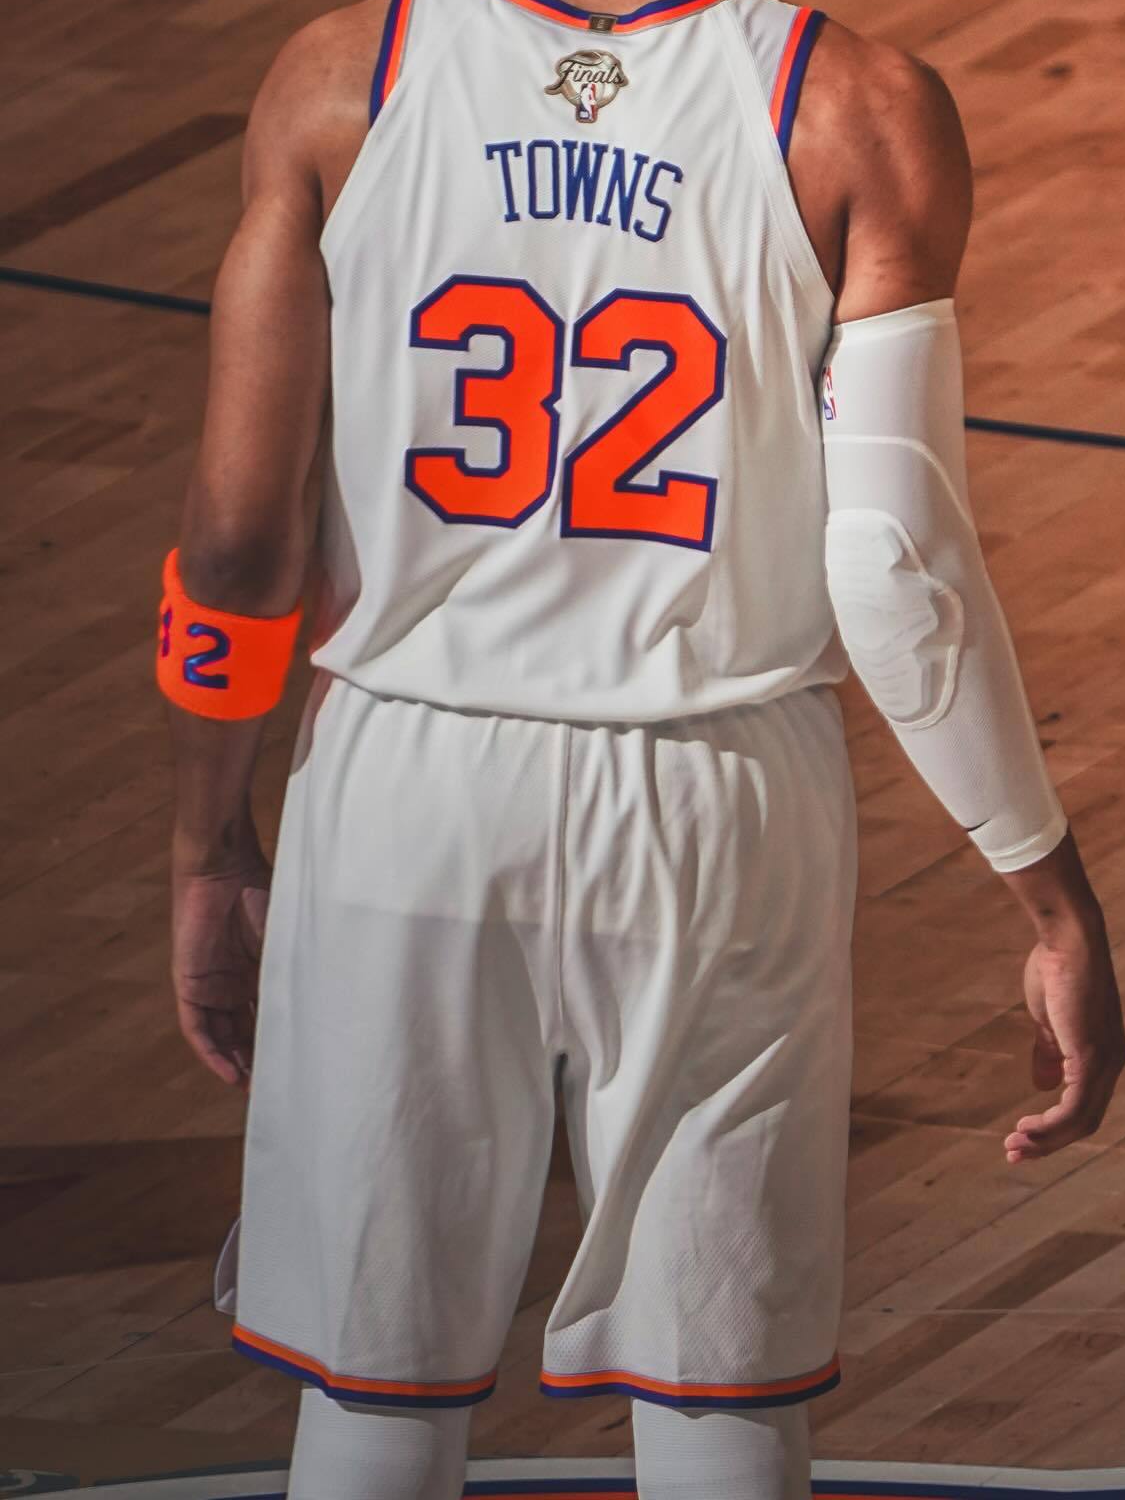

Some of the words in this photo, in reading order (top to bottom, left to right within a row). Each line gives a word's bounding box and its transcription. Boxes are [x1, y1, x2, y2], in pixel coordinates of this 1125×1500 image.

[545, 57, 626, 92] Finals
[485, 139, 684, 243] TOWNS
[404, 274, 728, 553] 32
[161, 604, 231, 690] 2
